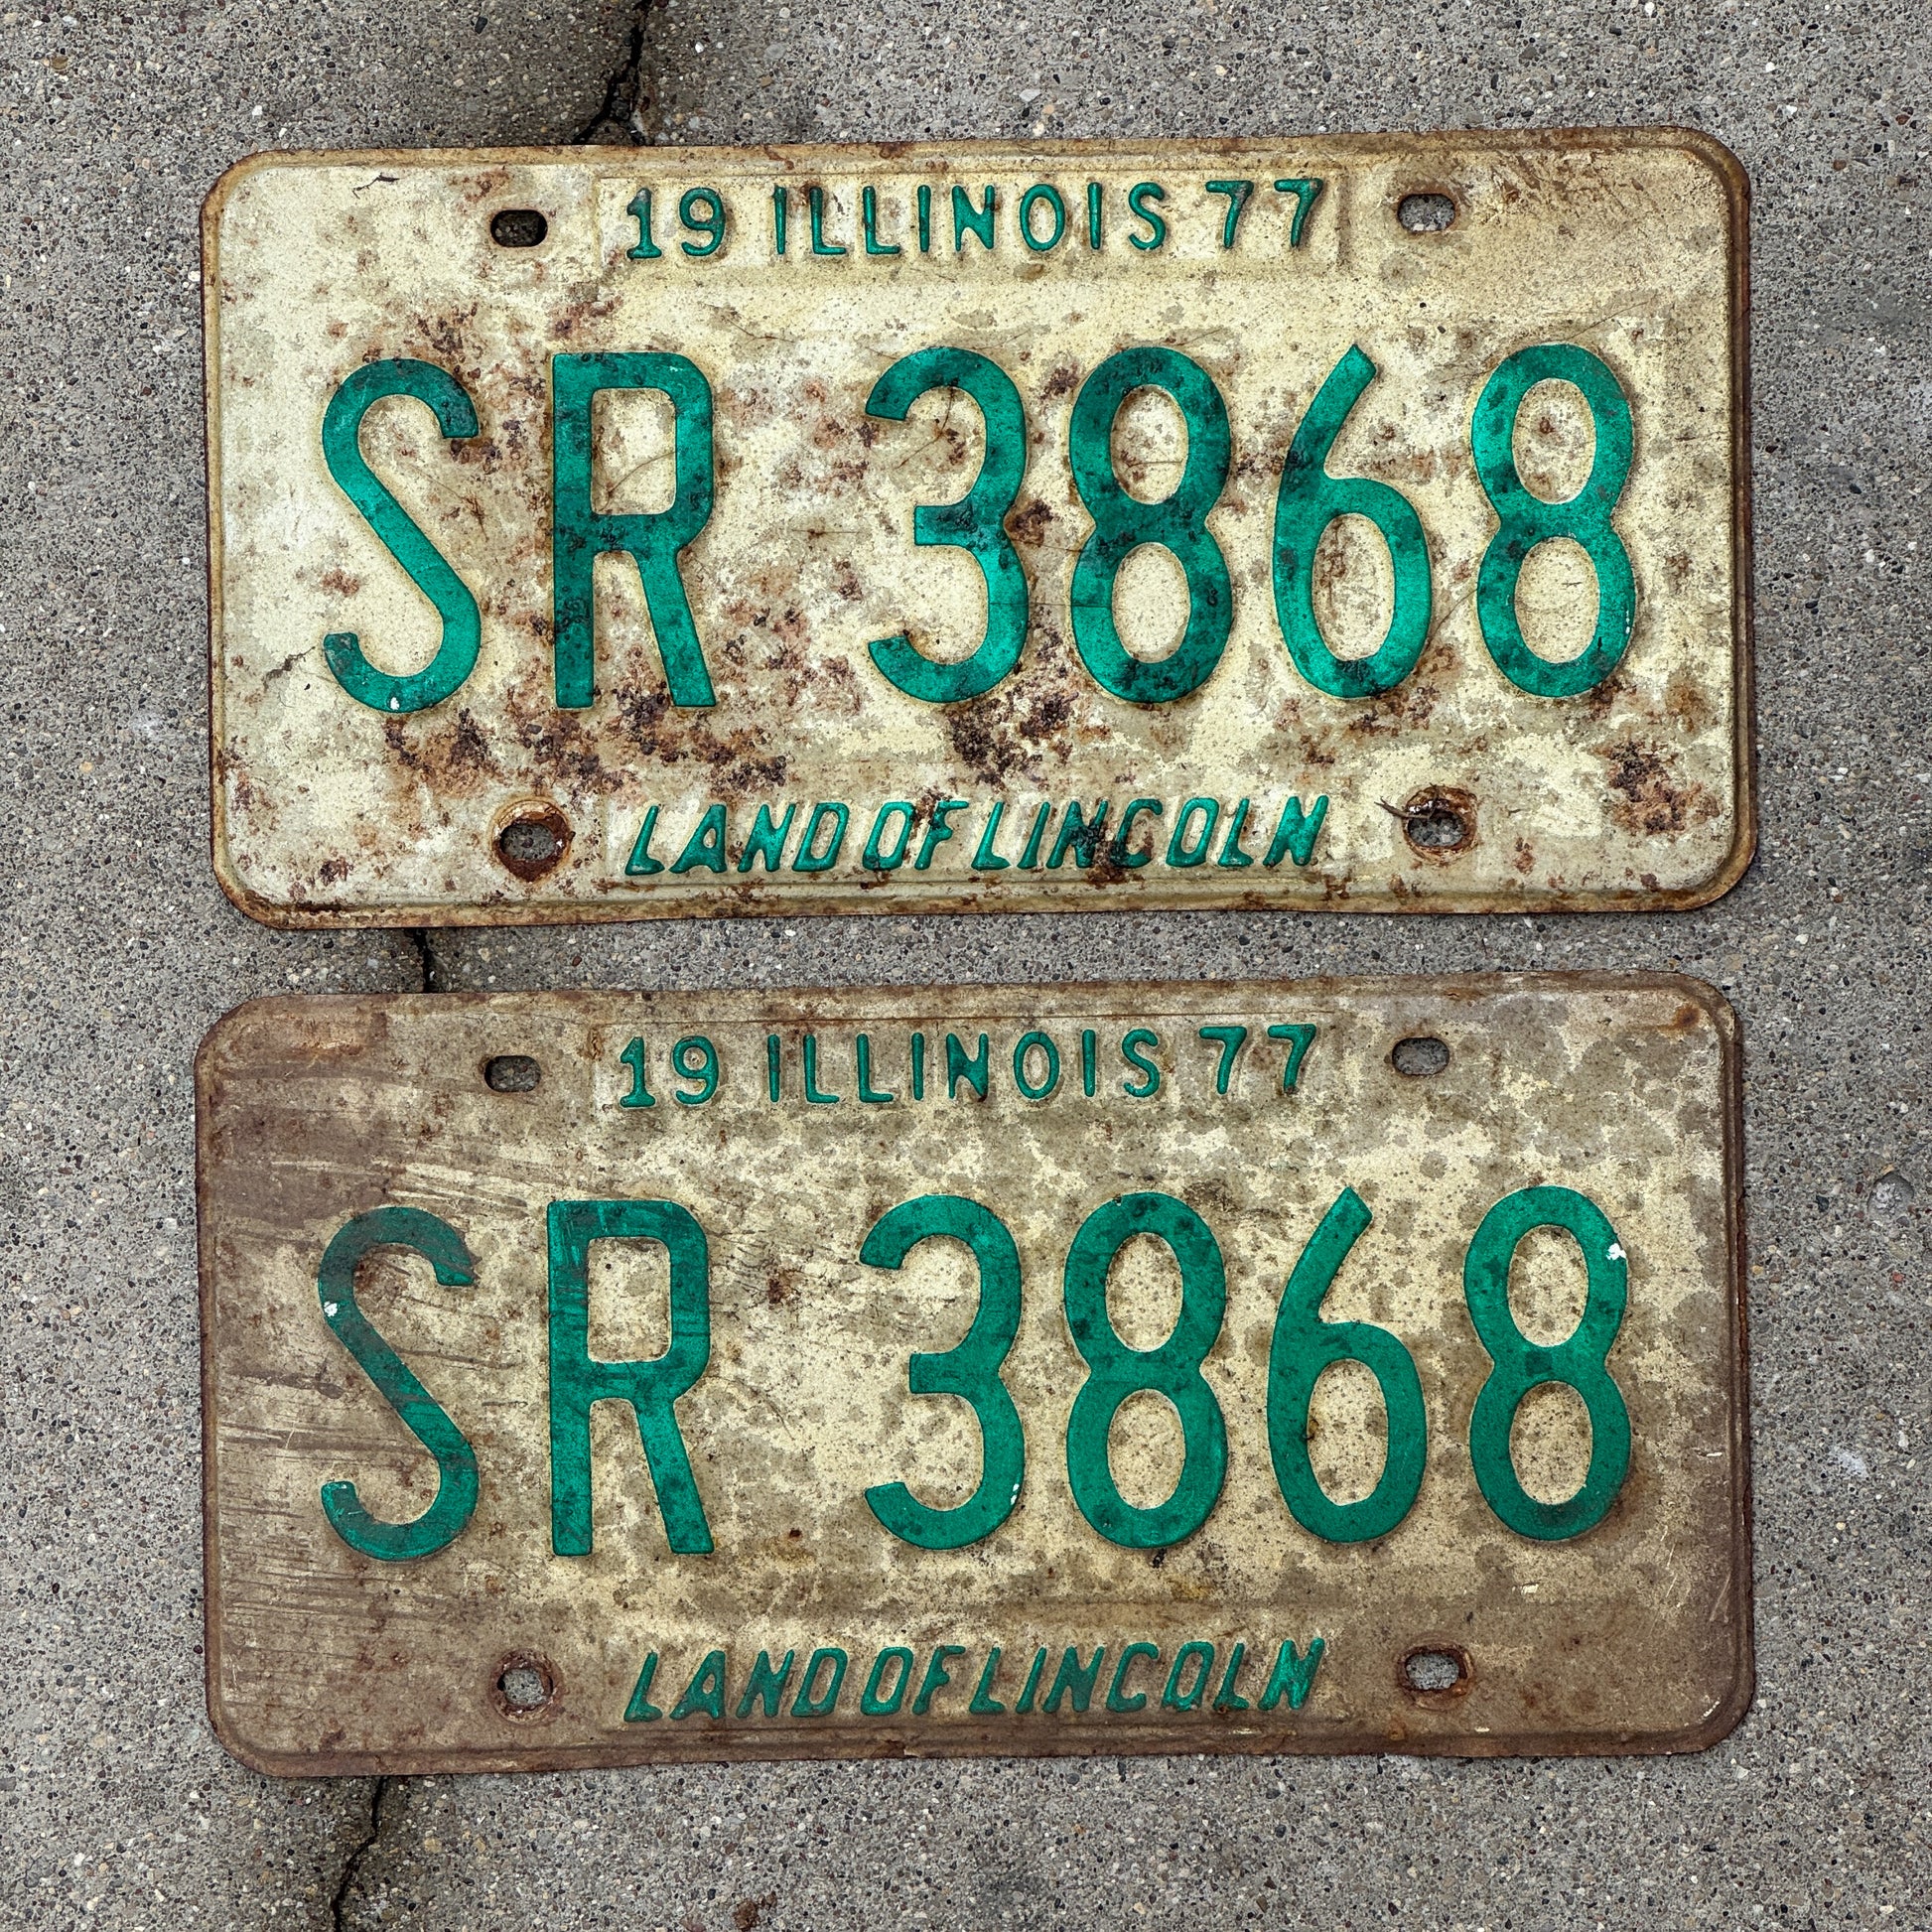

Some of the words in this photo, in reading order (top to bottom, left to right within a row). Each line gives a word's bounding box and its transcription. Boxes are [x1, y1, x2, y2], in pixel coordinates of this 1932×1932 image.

[625, 186, 727, 260] 19
[773, 181, 1168, 258] ILLINOIS
[1204, 178, 1324, 250] 77
[321, 350, 717, 714] SR
[864, 342, 1637, 705] 3868
[623, 800, 851, 877] LAND
[860, 798, 970, 873] OF
[969, 793, 1331, 872] LINCOLN
[618, 1035, 721, 1110] 19
[765, 1027, 1162, 1106] ILLINOIS
[1198, 1022, 1317, 1096] 77
[317, 1197, 716, 1563] SR
[859, 1182, 1633, 1552] 3868
[623, 1646, 851, 1724] LAND
[860, 1643, 966, 1717] OF
[968, 1636, 1326, 1715] LINCOLN
